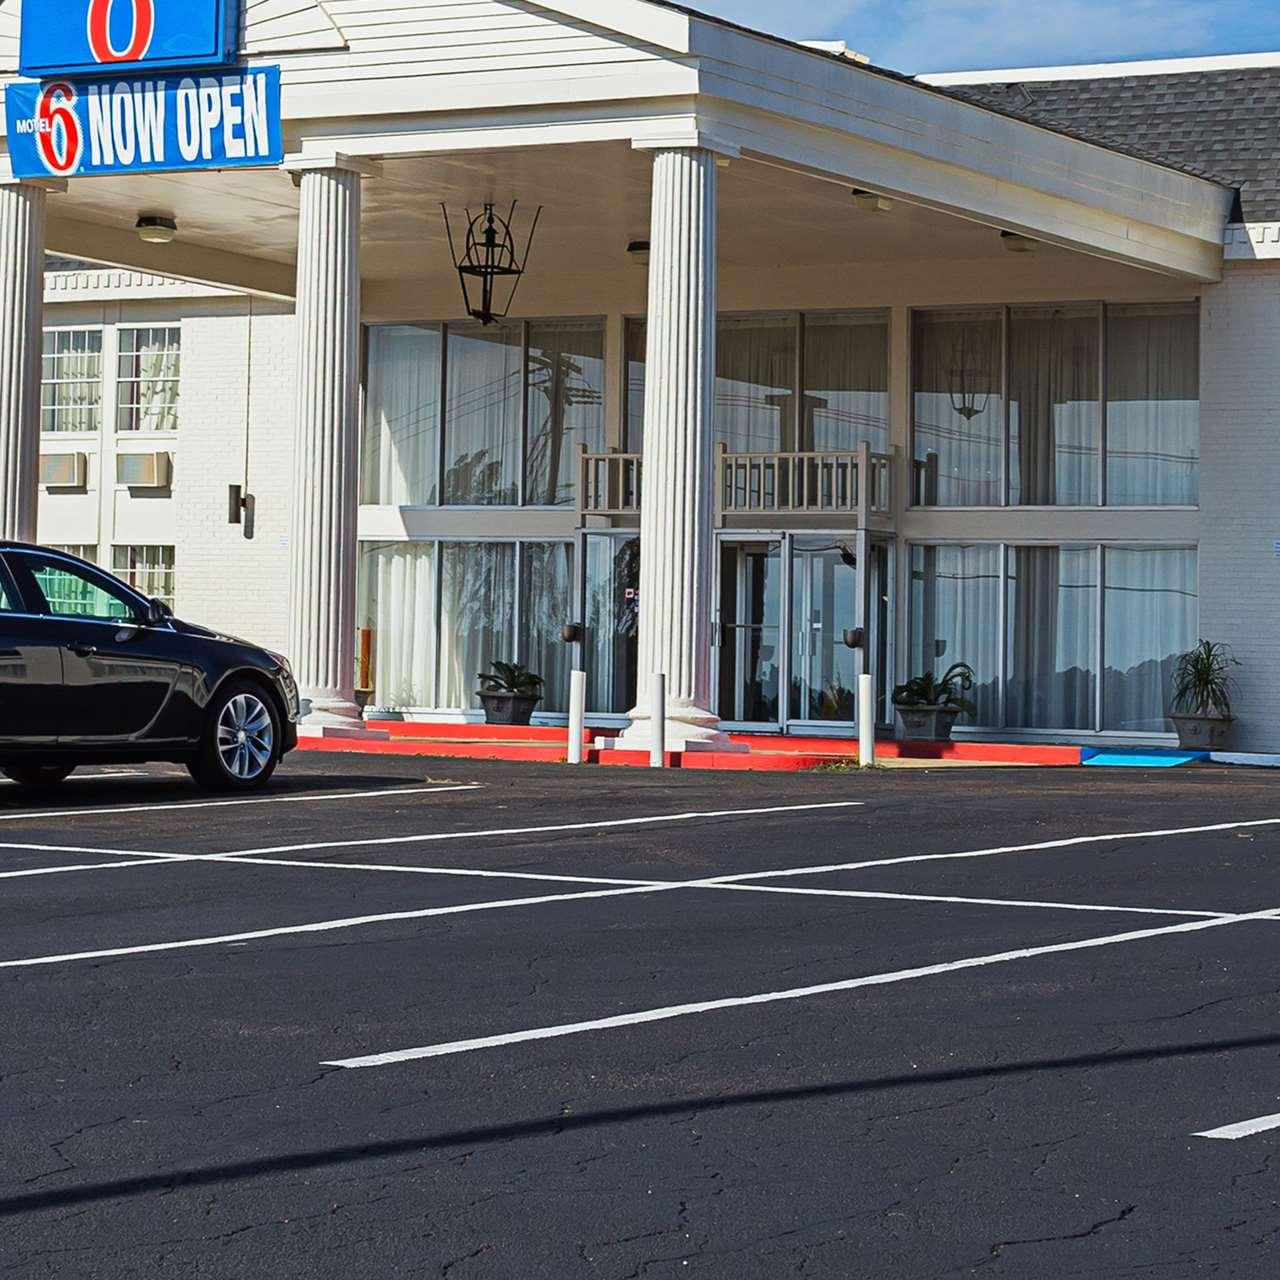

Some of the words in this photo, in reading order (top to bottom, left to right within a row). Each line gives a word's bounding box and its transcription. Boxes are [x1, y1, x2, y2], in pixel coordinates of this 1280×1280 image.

[16, 118, 51, 134] MOTEL
[35, 81, 83, 176] 6
[88, 80, 166, 166] NOW
[176, 73, 269, 161] OPEN
